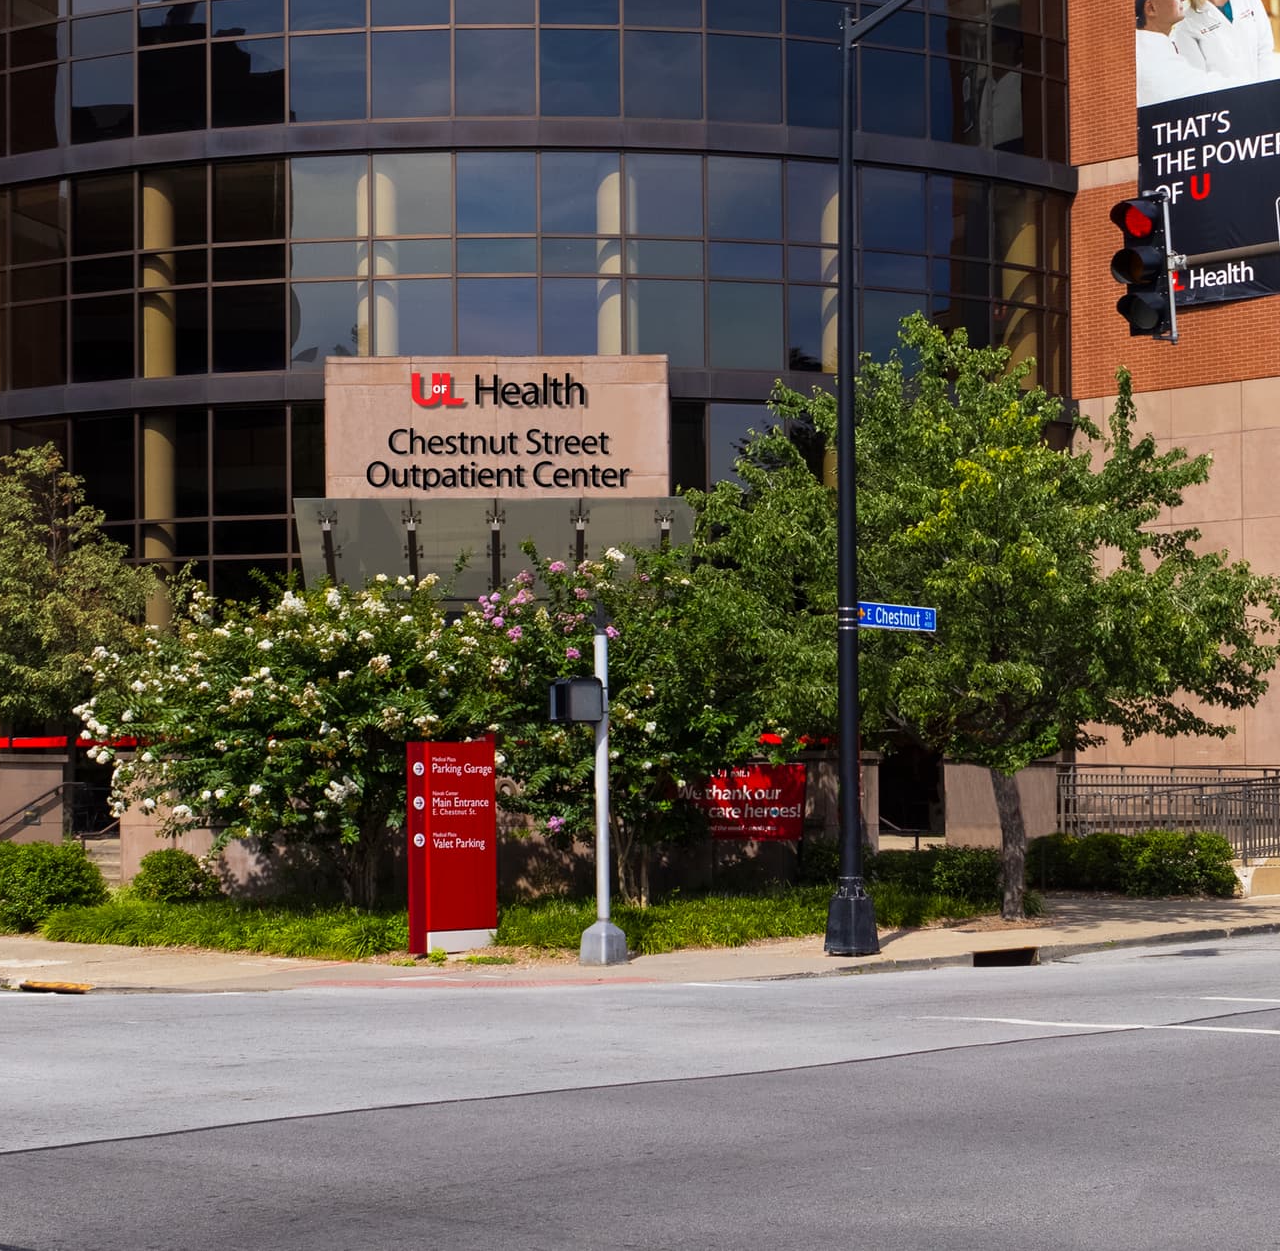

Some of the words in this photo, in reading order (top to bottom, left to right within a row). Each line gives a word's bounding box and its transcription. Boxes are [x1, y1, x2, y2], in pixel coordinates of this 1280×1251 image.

[1153, 149, 1196, 176] THE
[1190, 173, 1211, 201] U
[1189, 261, 1254, 289] Health
[474, 373, 586, 406] Health
[388, 428, 518, 455] Chestnut
[526, 428, 610, 455] Street
[366, 461, 525, 490] Outpatient
[533, 461, 630, 488] Center
[867, 608, 872, 621] E
[875, 607, 920, 627] Chestnut
[925, 611, 931, 620] St
[432, 763, 462, 776] Parking
[464, 763, 492, 776] Garage
[432, 797, 452, 807] Main
[454, 797, 489, 807] Entrance
[705, 784, 752, 800] thank
[754, 789, 782, 800] our
[708, 807, 740, 818] care
[744, 803, 801, 818] heroes!
[433, 838, 453, 848] Valet
[456, 838, 486, 851] Parking
